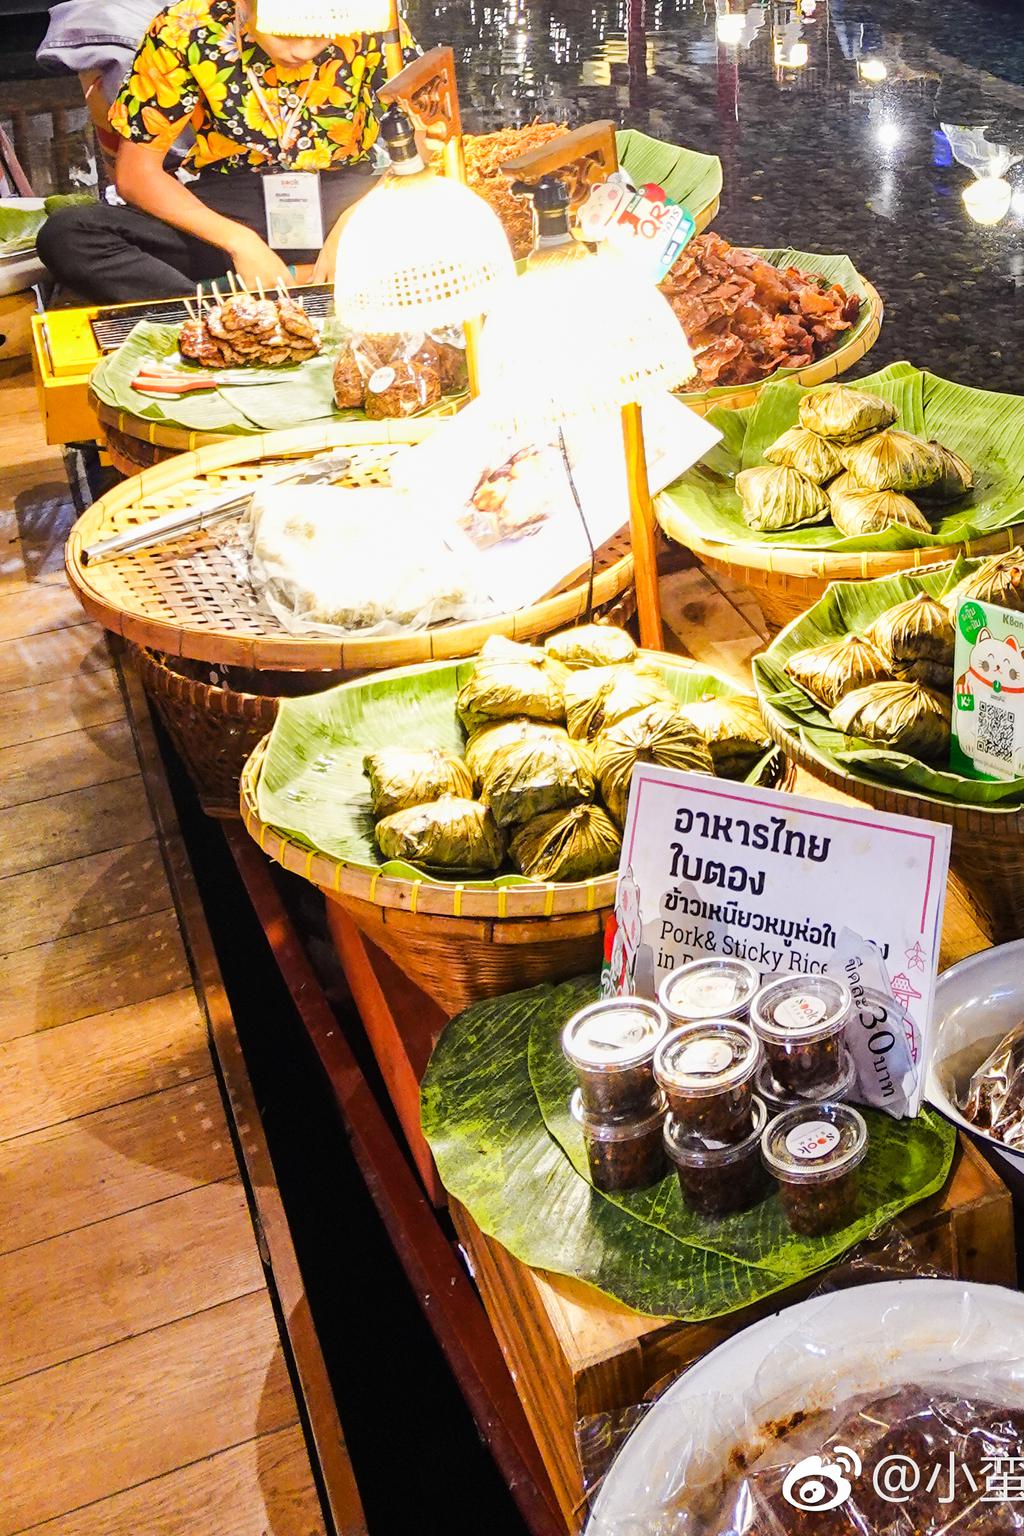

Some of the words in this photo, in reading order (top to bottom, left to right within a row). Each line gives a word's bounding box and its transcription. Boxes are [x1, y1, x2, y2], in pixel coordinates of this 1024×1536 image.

[640, 204, 670, 239] QR
[674, 808, 831, 862] อาหารไทย
[669, 842, 766, 896] ใบตอง
[656, 947, 675, 970] in
[722, 935, 784, 972] Sticky
